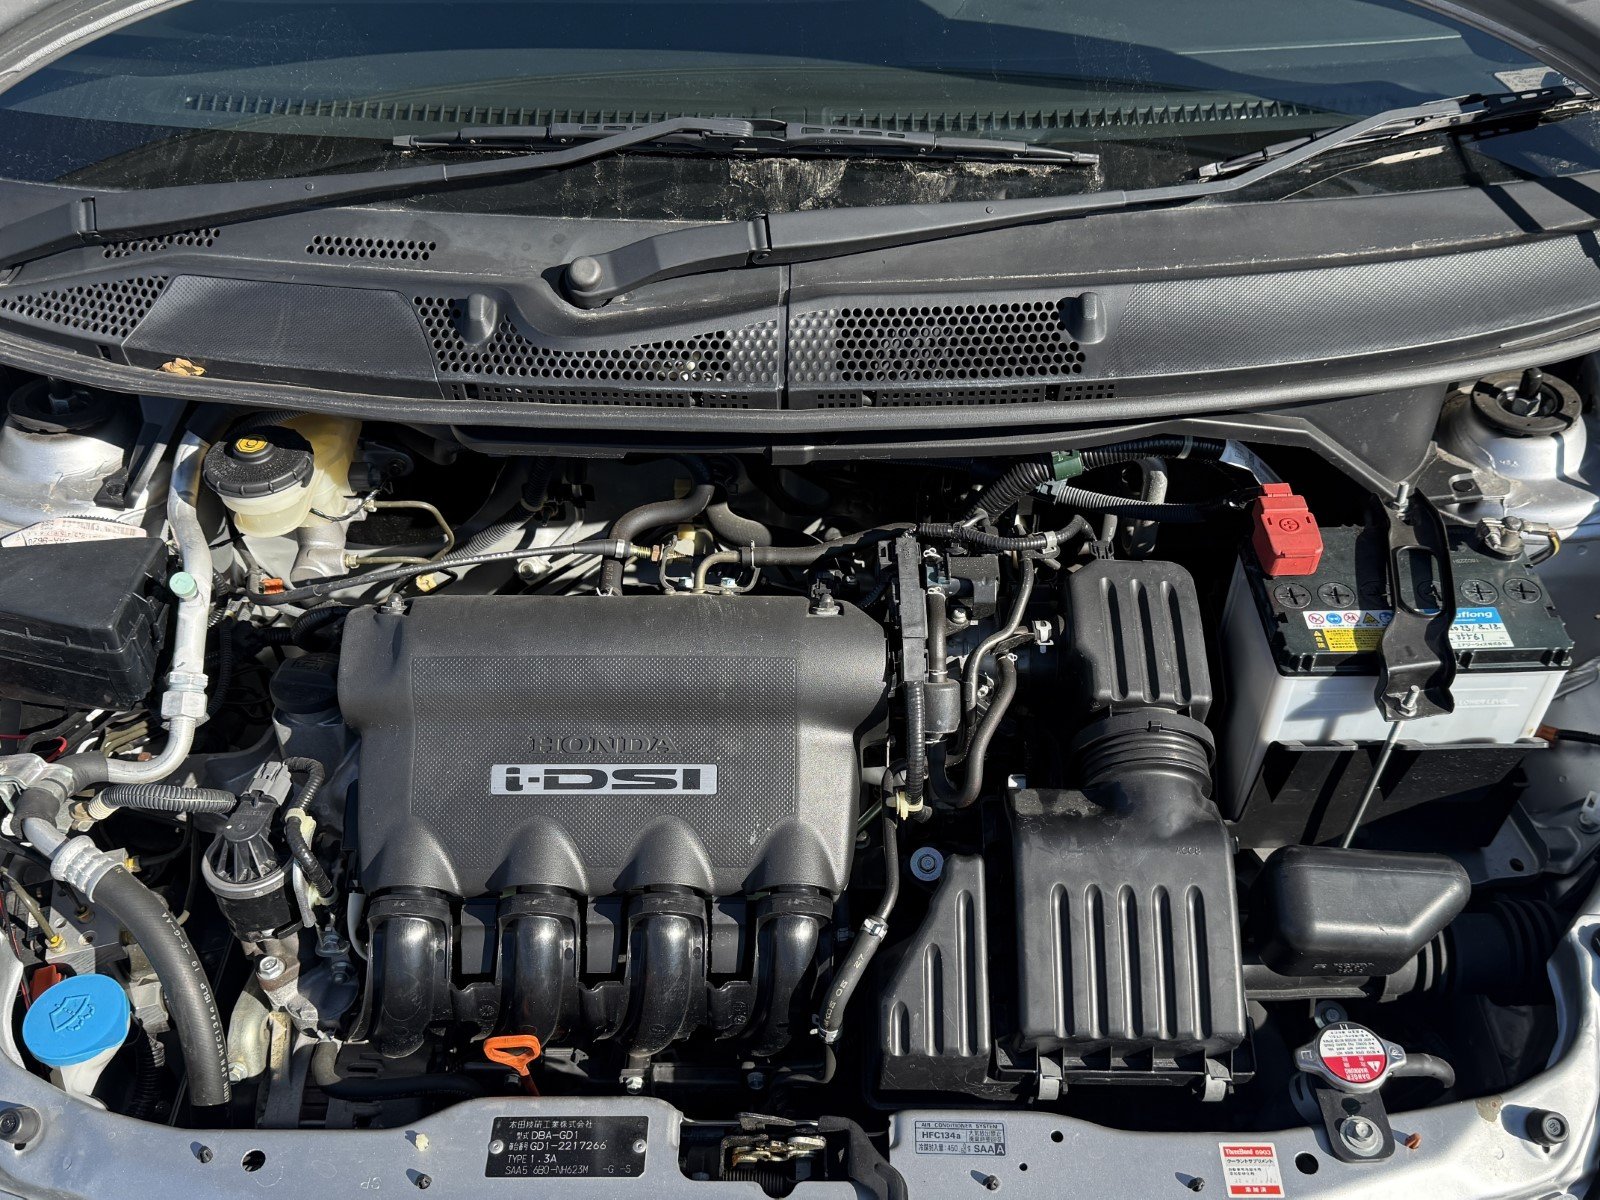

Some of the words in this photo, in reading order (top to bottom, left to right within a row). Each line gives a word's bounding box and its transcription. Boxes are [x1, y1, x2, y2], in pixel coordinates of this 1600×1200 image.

[529, 736, 681, 755] HONDA
[505, 767, 701, 791] i-DSI
[508, 1119, 593, 1129] 本田技研工業株式会社
[531, 1131, 578, 1140] DBA-GD1
[921, 1131, 961, 1140] HFC134a
[530, 1141, 607, 1151] GD1-2217266
[507, 1154, 527, 1164] TYPE
[505, 1166, 528, 1175] SAA5
